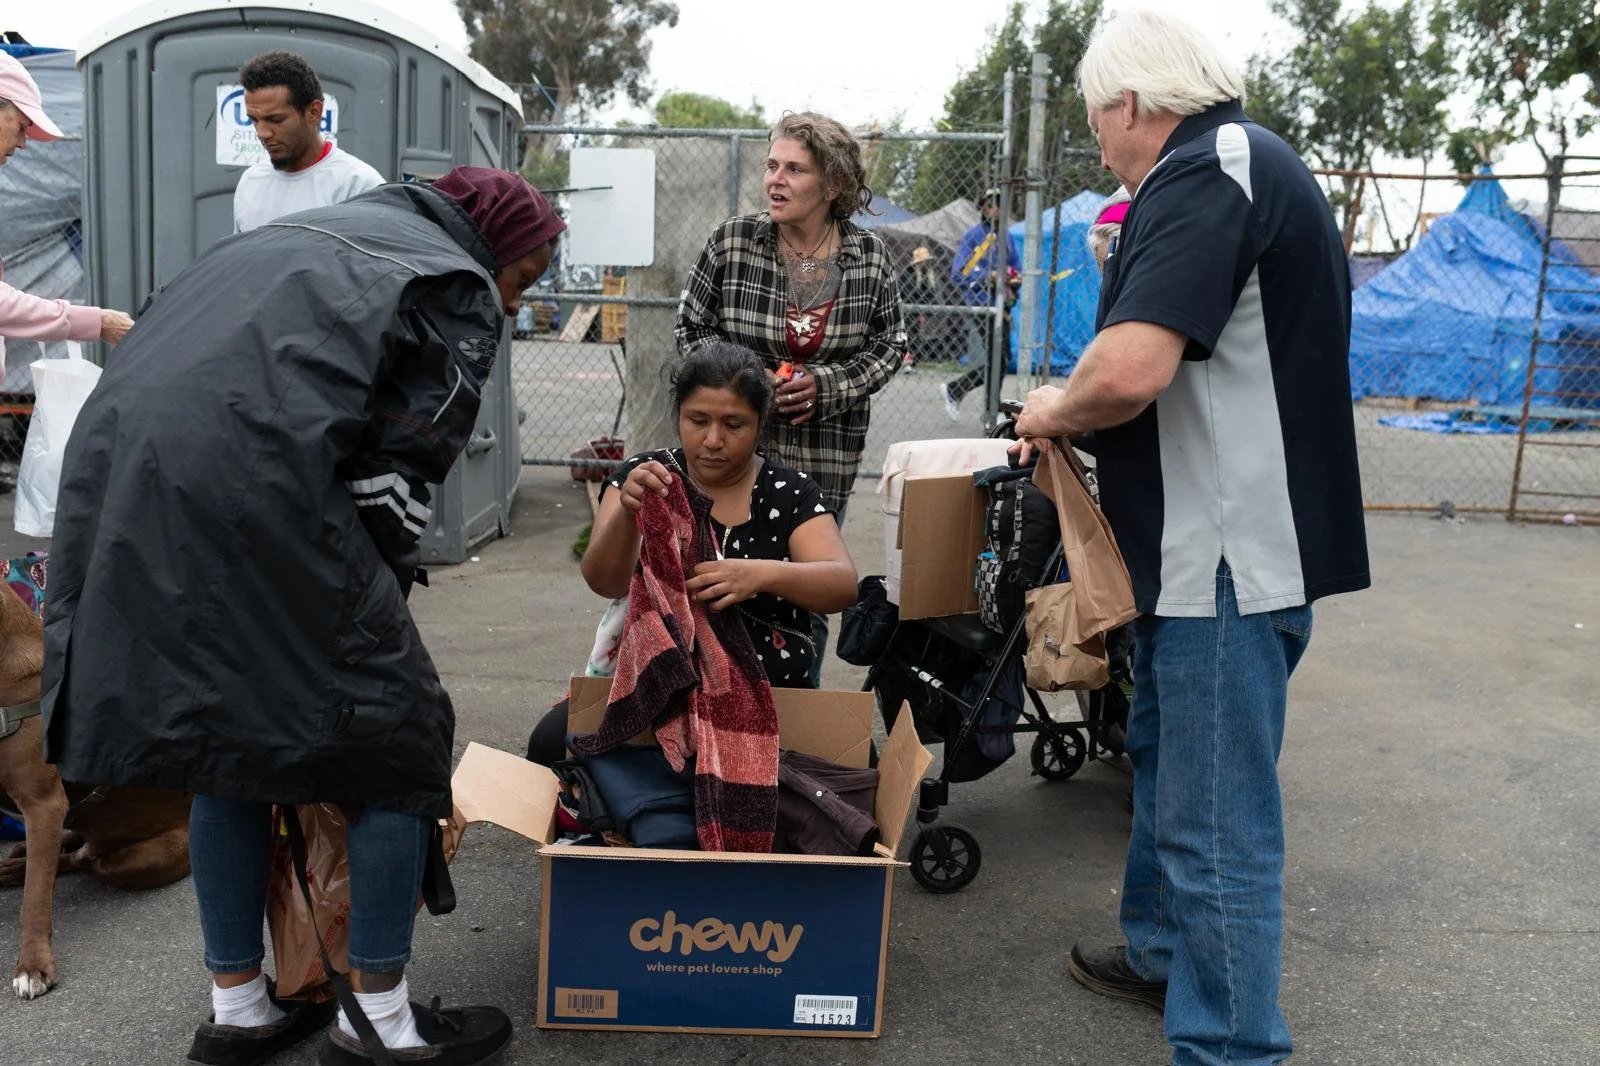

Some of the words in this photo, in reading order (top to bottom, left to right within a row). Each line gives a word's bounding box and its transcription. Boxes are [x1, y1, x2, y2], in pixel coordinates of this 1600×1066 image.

[234, 129, 258, 141] SIT
[629, 910, 804, 963] chewy
[646, 961, 685, 972] where
[688, 963, 709, 975] pet
[712, 963, 750, 974] lovers
[753, 964, 782, 977] shop
[812, 1013, 852, 1025] 11523
